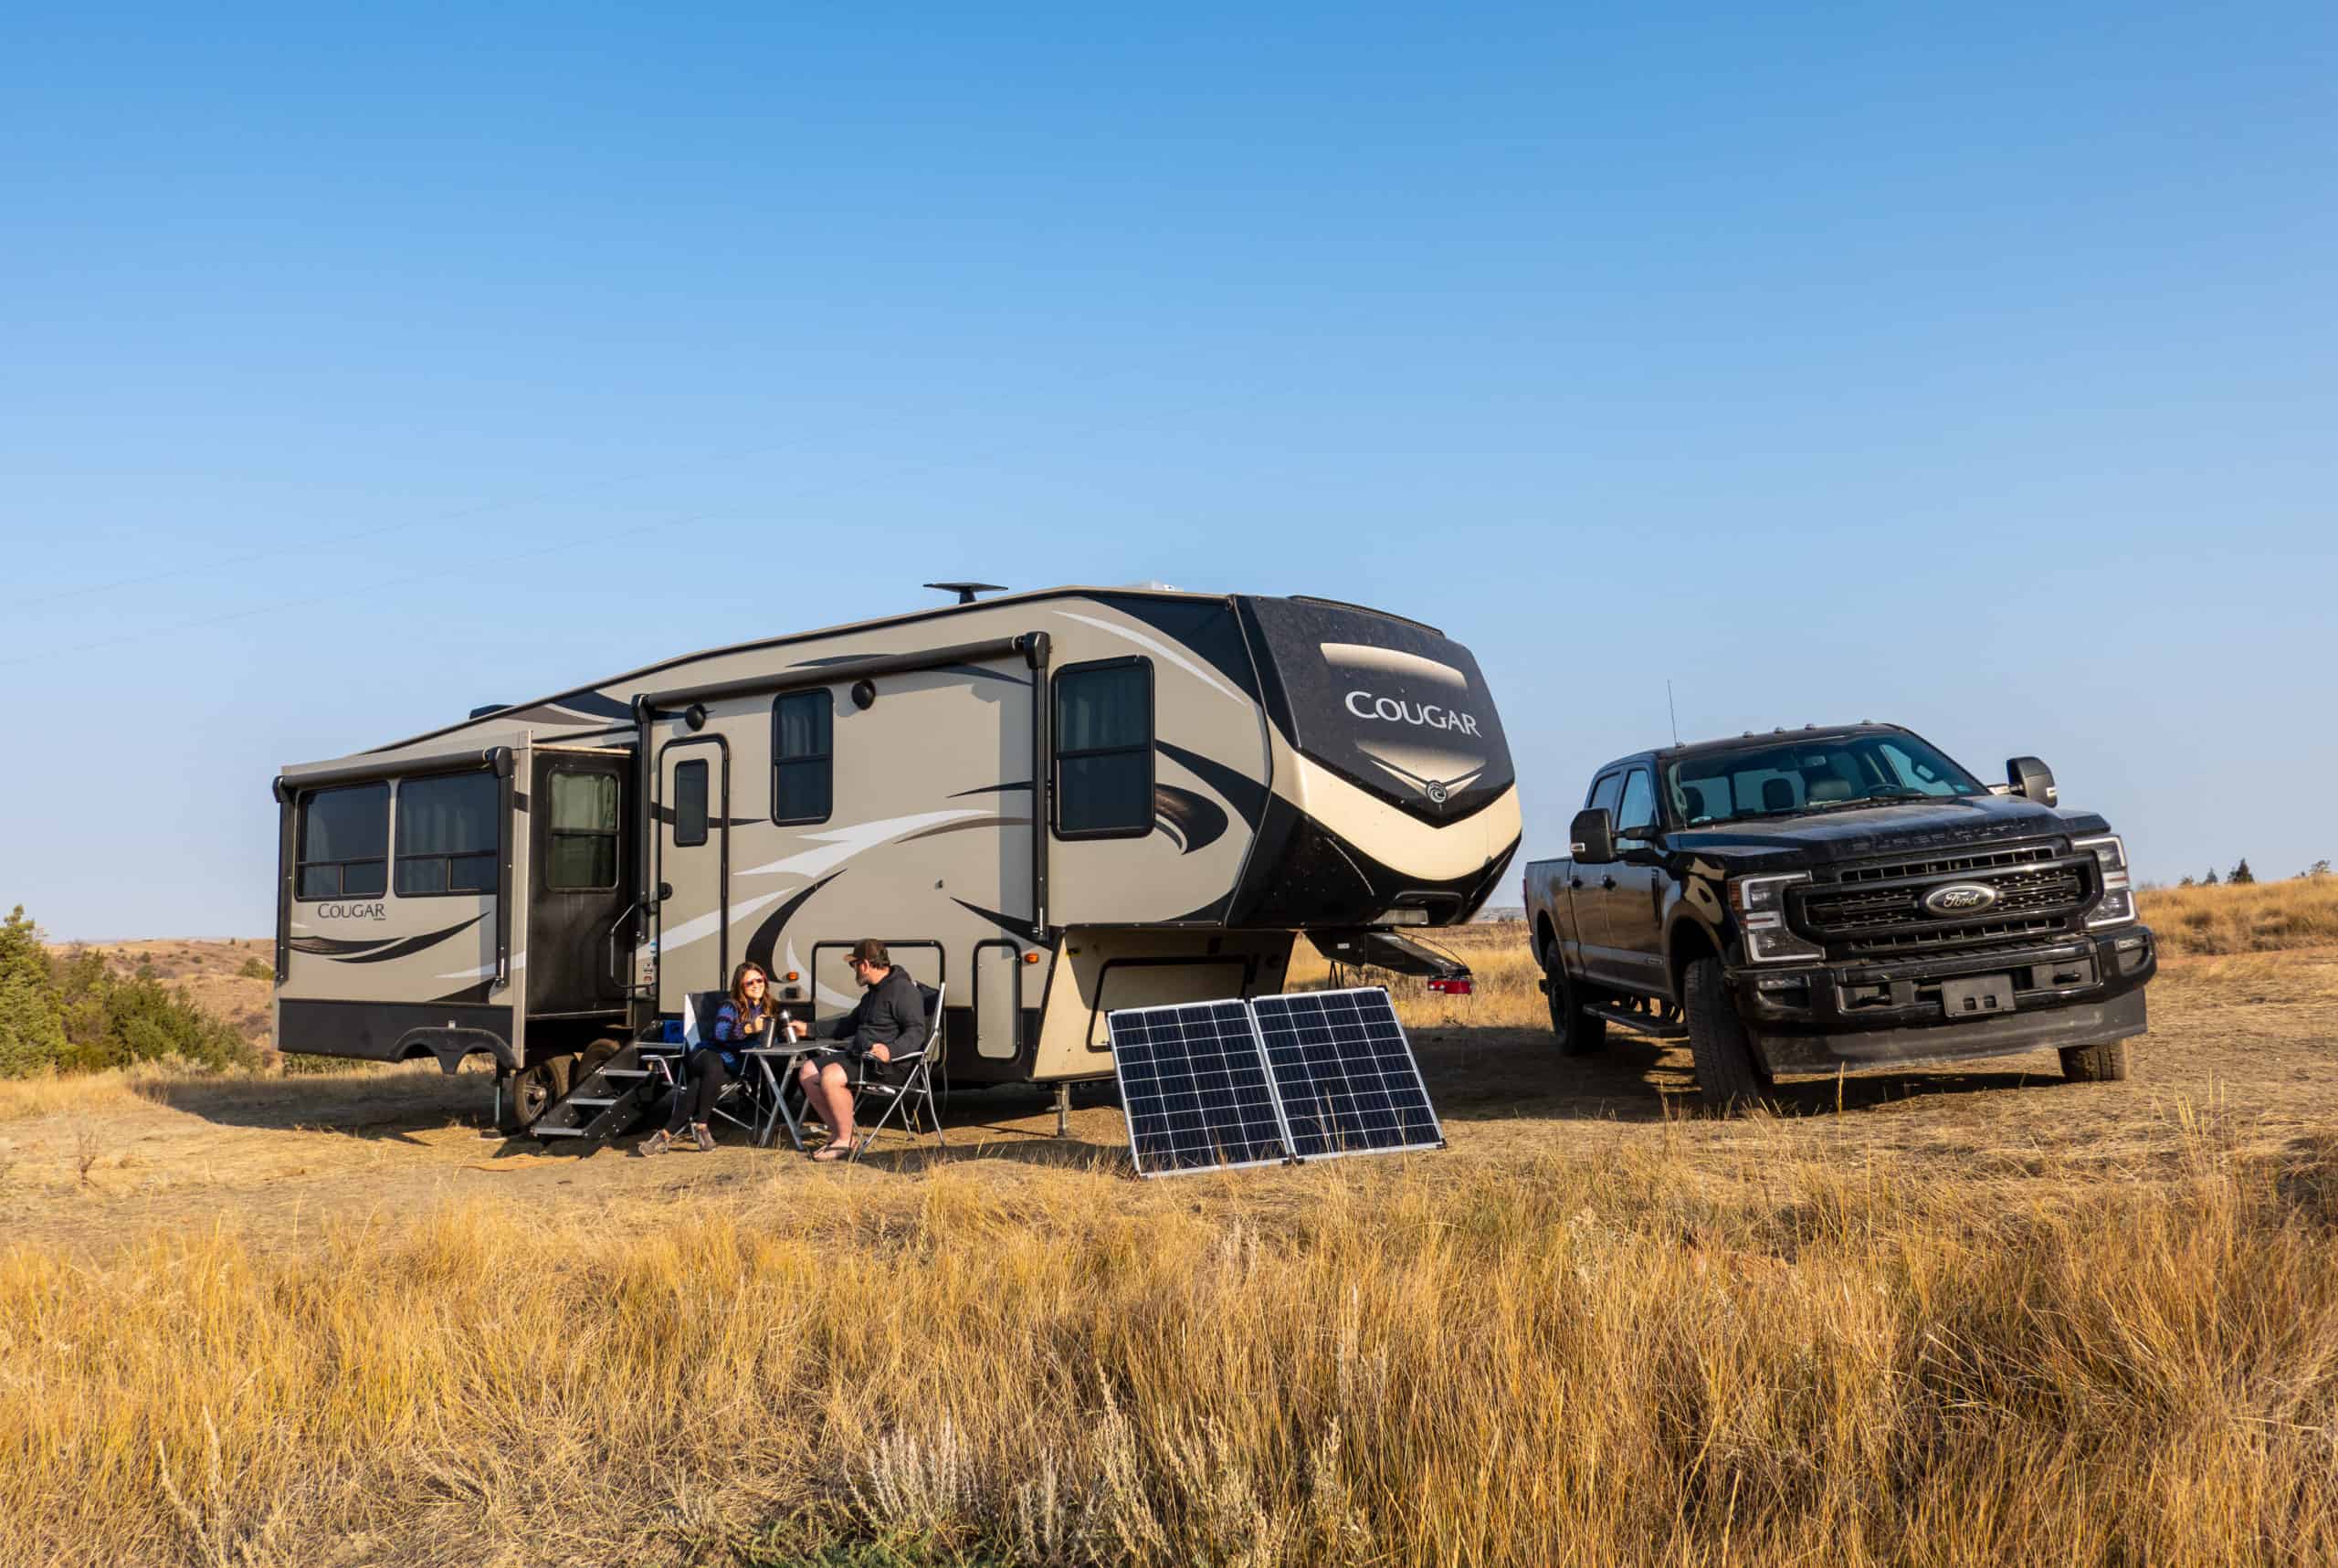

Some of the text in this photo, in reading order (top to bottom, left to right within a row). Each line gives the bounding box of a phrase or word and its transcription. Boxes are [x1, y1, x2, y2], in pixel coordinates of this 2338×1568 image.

[1345, 691, 1482, 738] COUGAR
[1943, 891, 1979, 908] Ford
[318, 903, 385, 919] COUGAR
